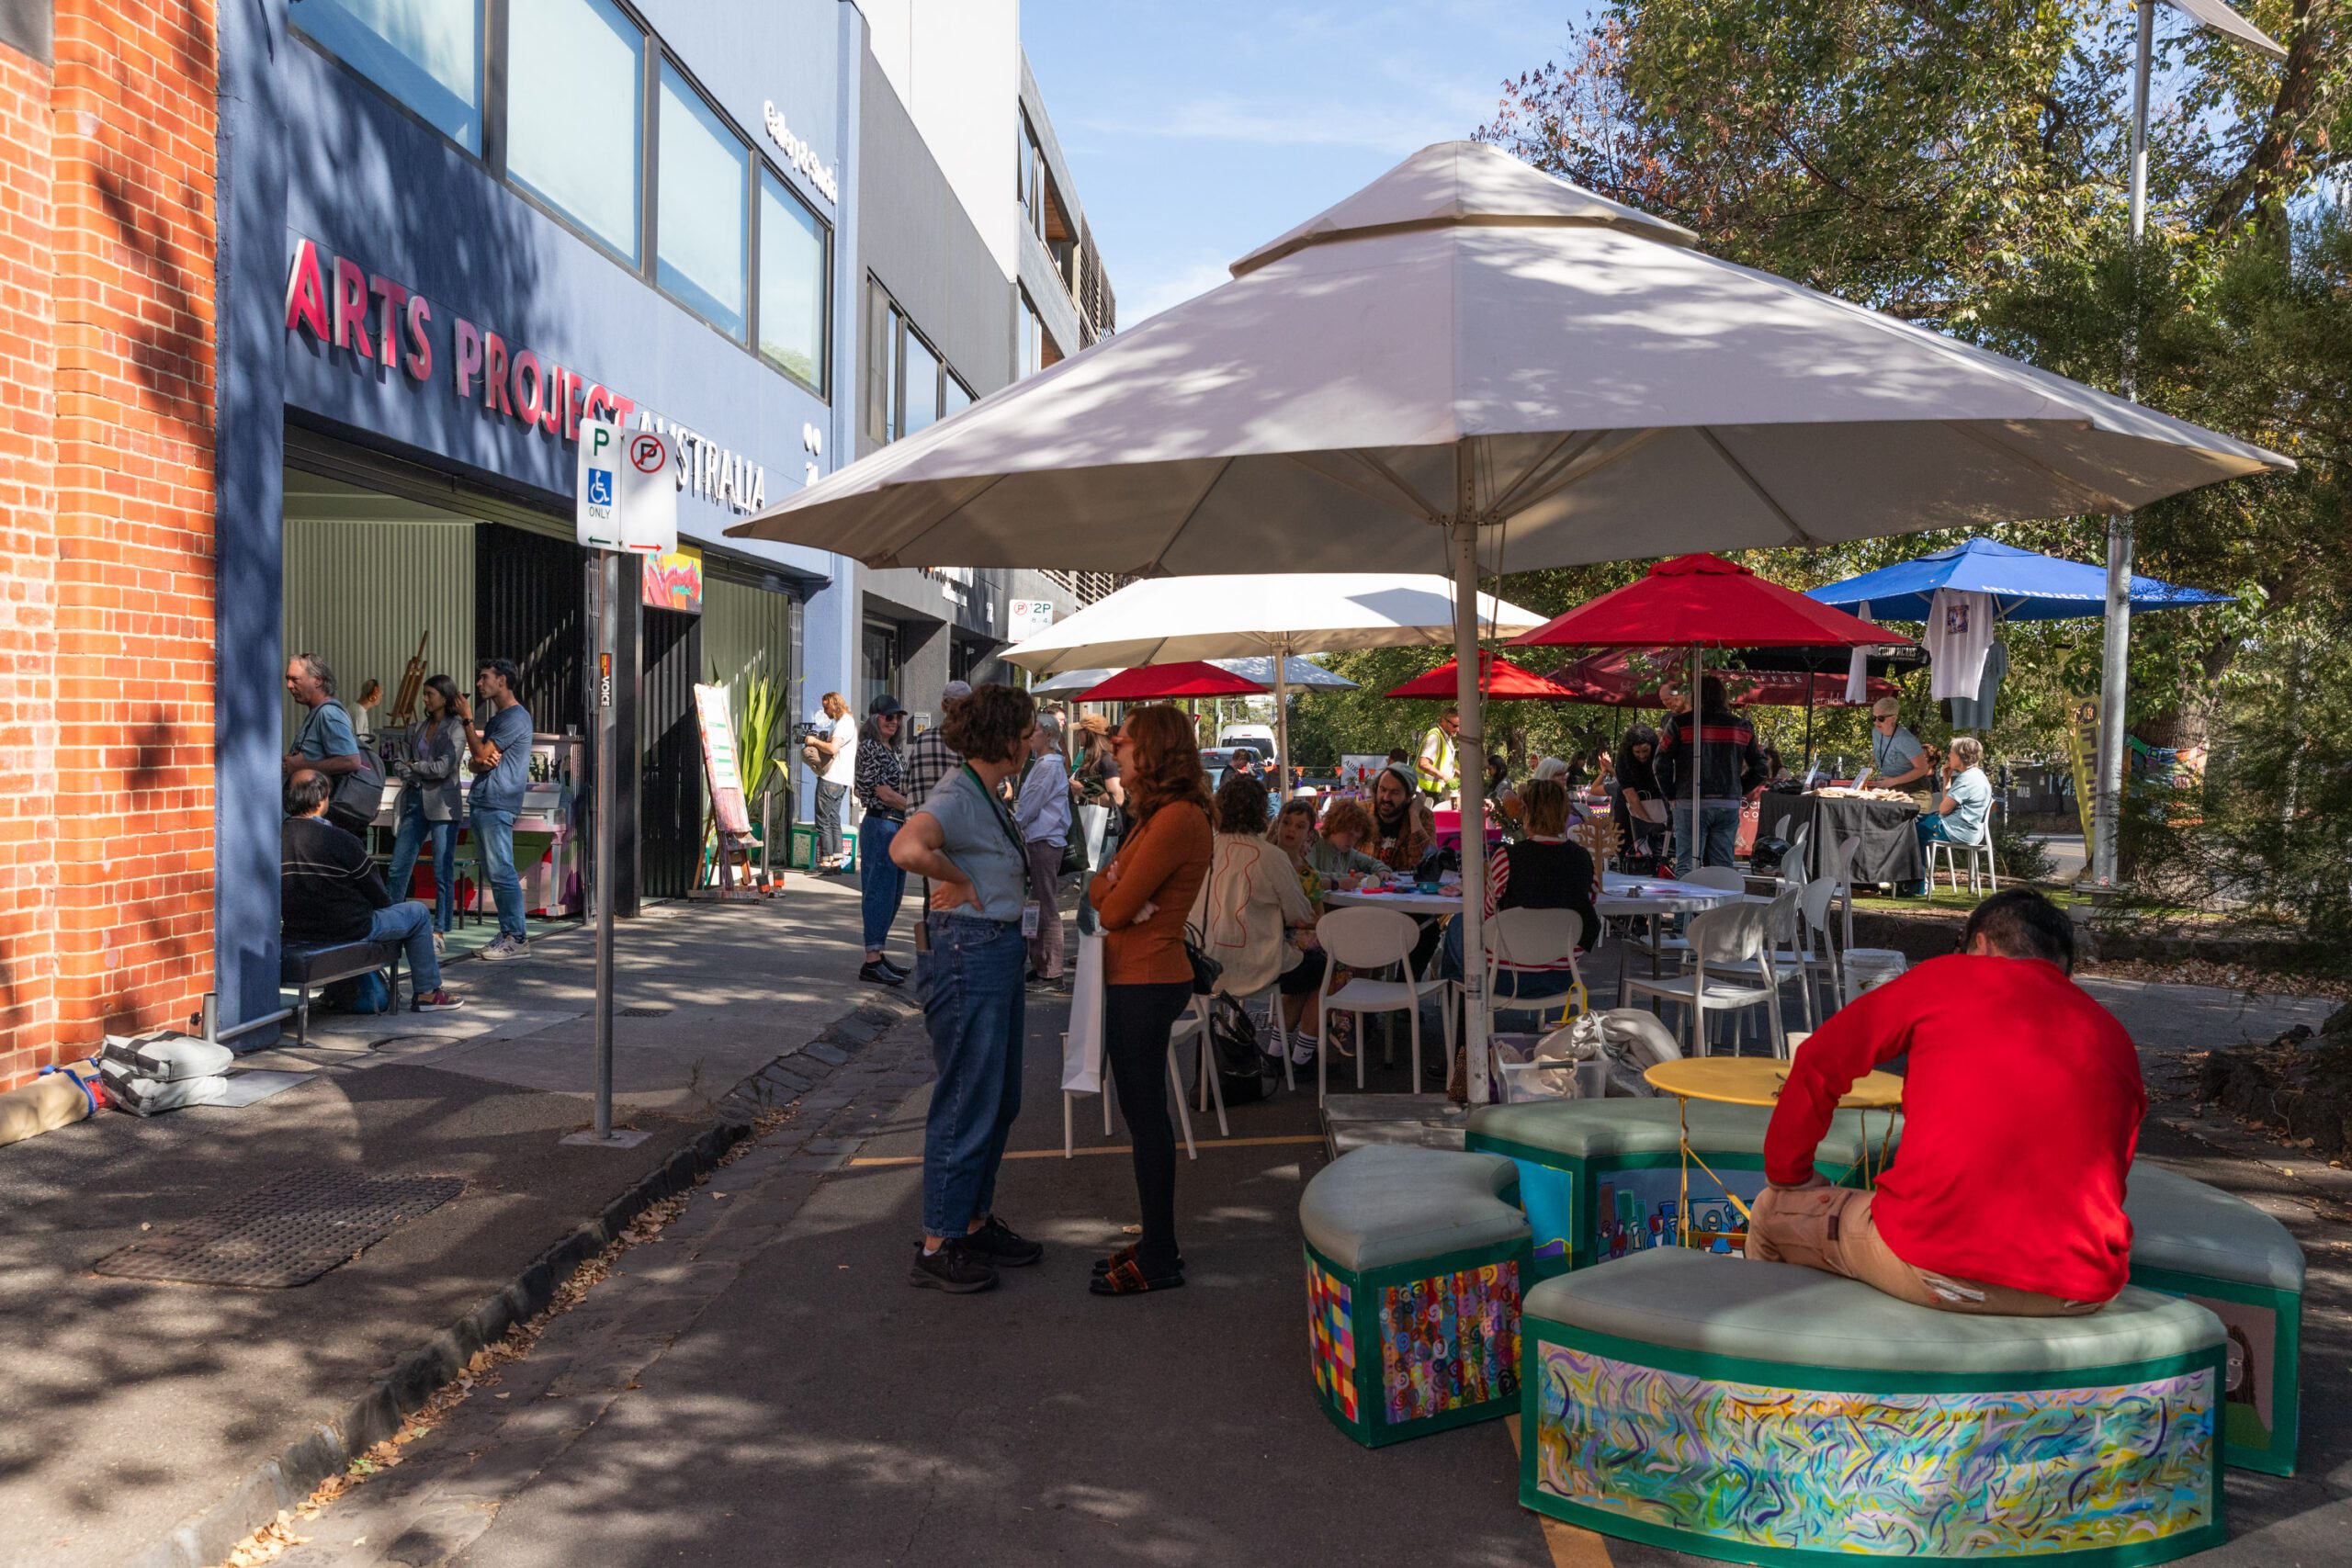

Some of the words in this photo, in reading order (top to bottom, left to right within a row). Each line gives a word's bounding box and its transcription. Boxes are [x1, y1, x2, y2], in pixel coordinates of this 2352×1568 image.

[286, 239, 432, 381] ARTS
[640, 411, 765, 512] STRALIA
[594, 427, 610, 457] P
[589, 506, 611, 519] ONLY
[1034, 603, 1051, 614] 2P
[601, 676, 610, 706] VOICE
[1813, 692, 1846, 705] eraldo
